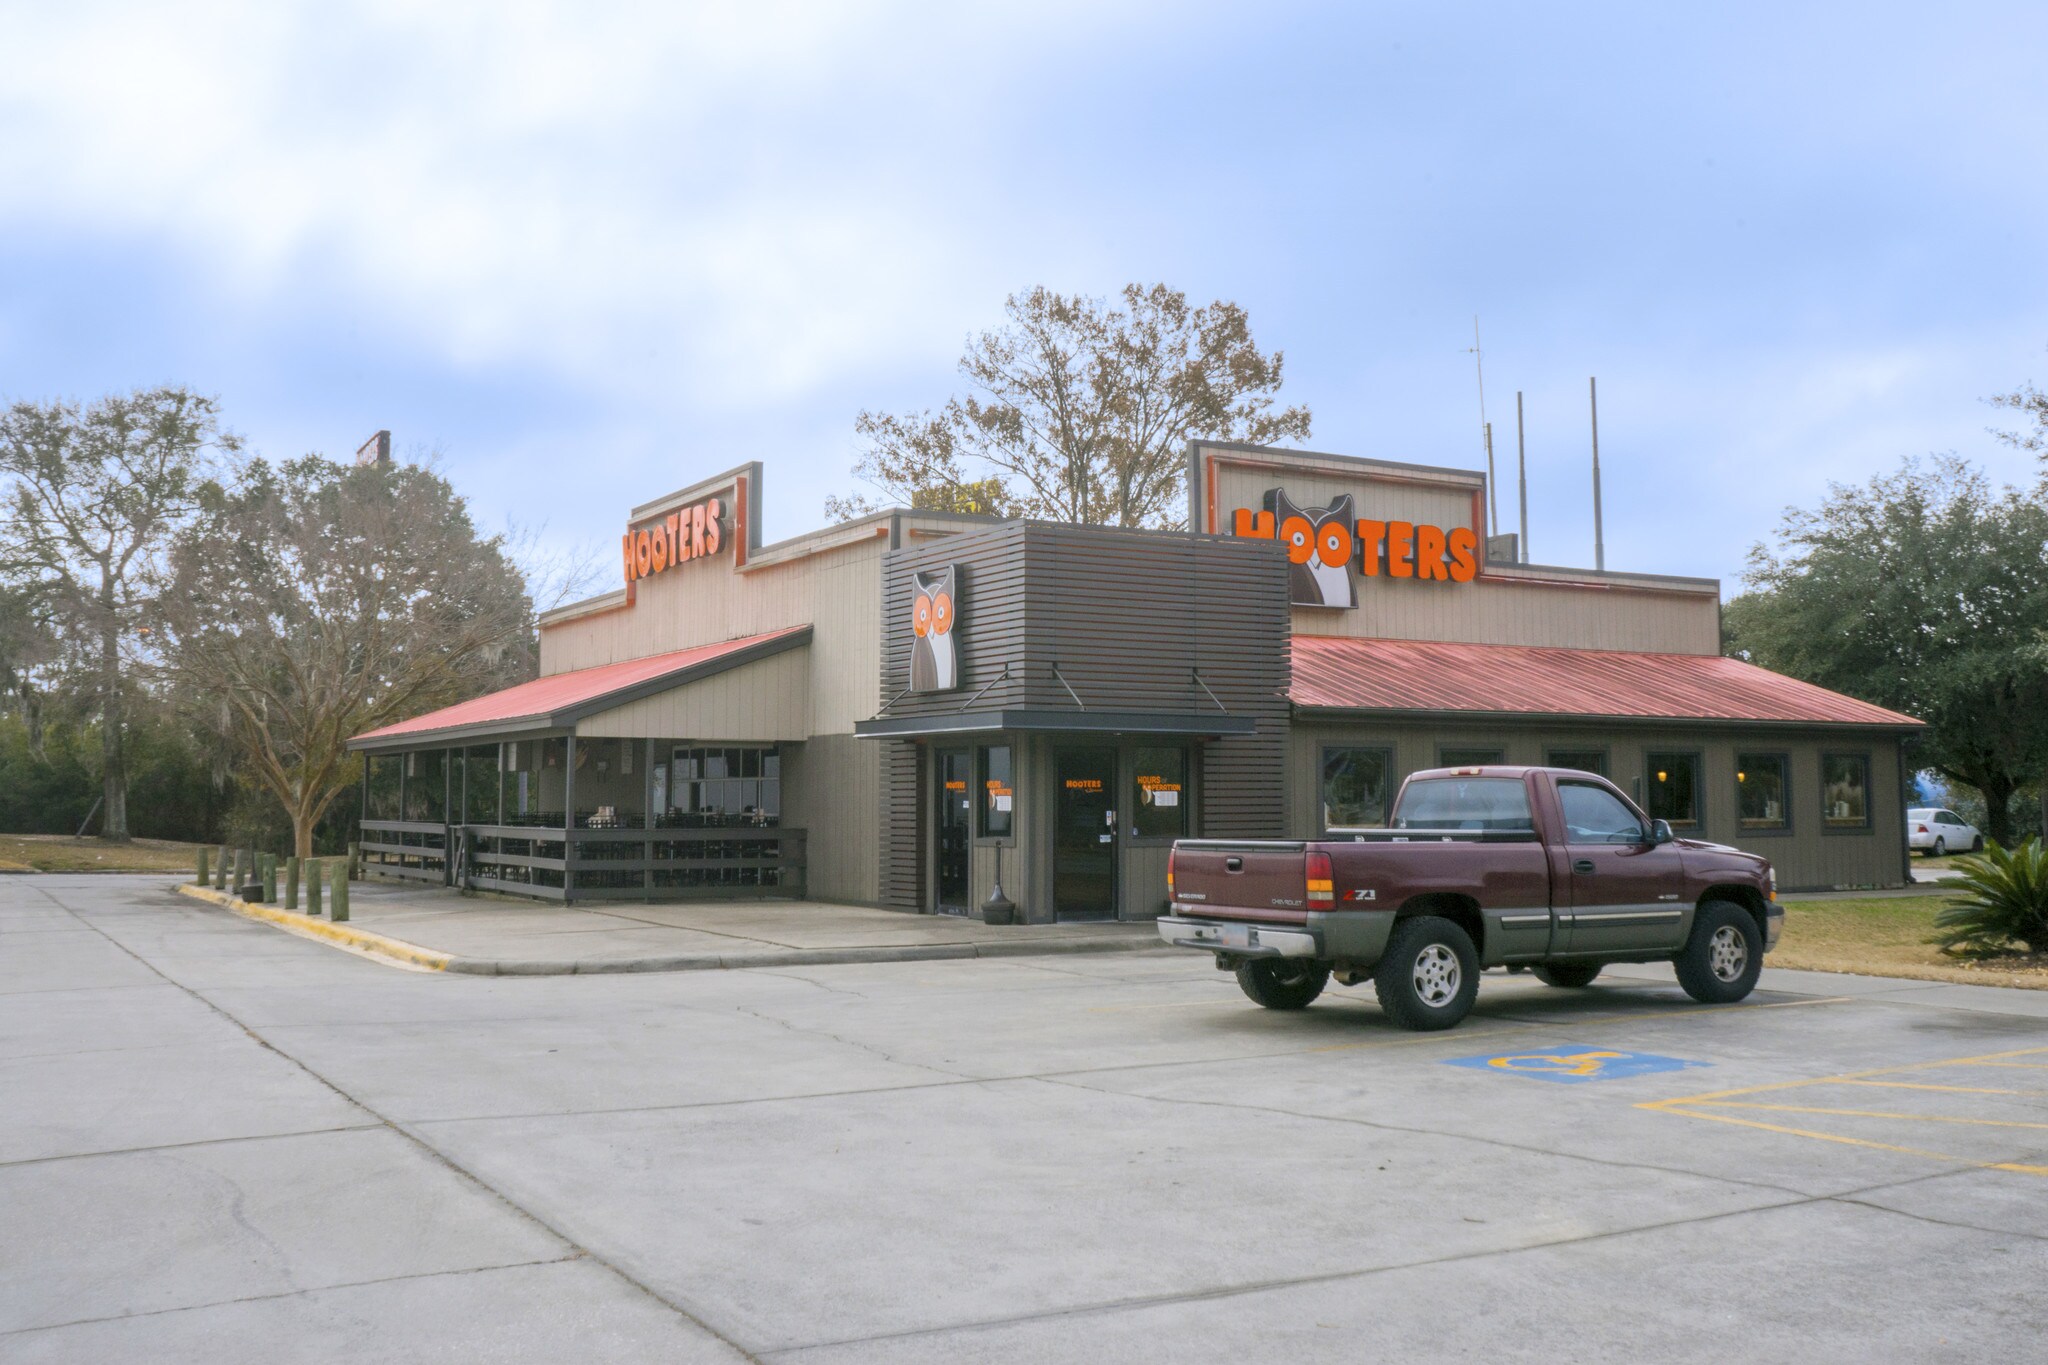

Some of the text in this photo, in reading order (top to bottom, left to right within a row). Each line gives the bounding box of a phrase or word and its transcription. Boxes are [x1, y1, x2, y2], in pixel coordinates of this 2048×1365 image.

[622, 498, 722, 582] HOOTERS
[1066, 780, 1102, 788] HOOTERS
[1137, 775, 1161, 784] HOURS
[1343, 889, 1376, 900] Z71
[1271, 898, 1303, 907] CHEVROLET
